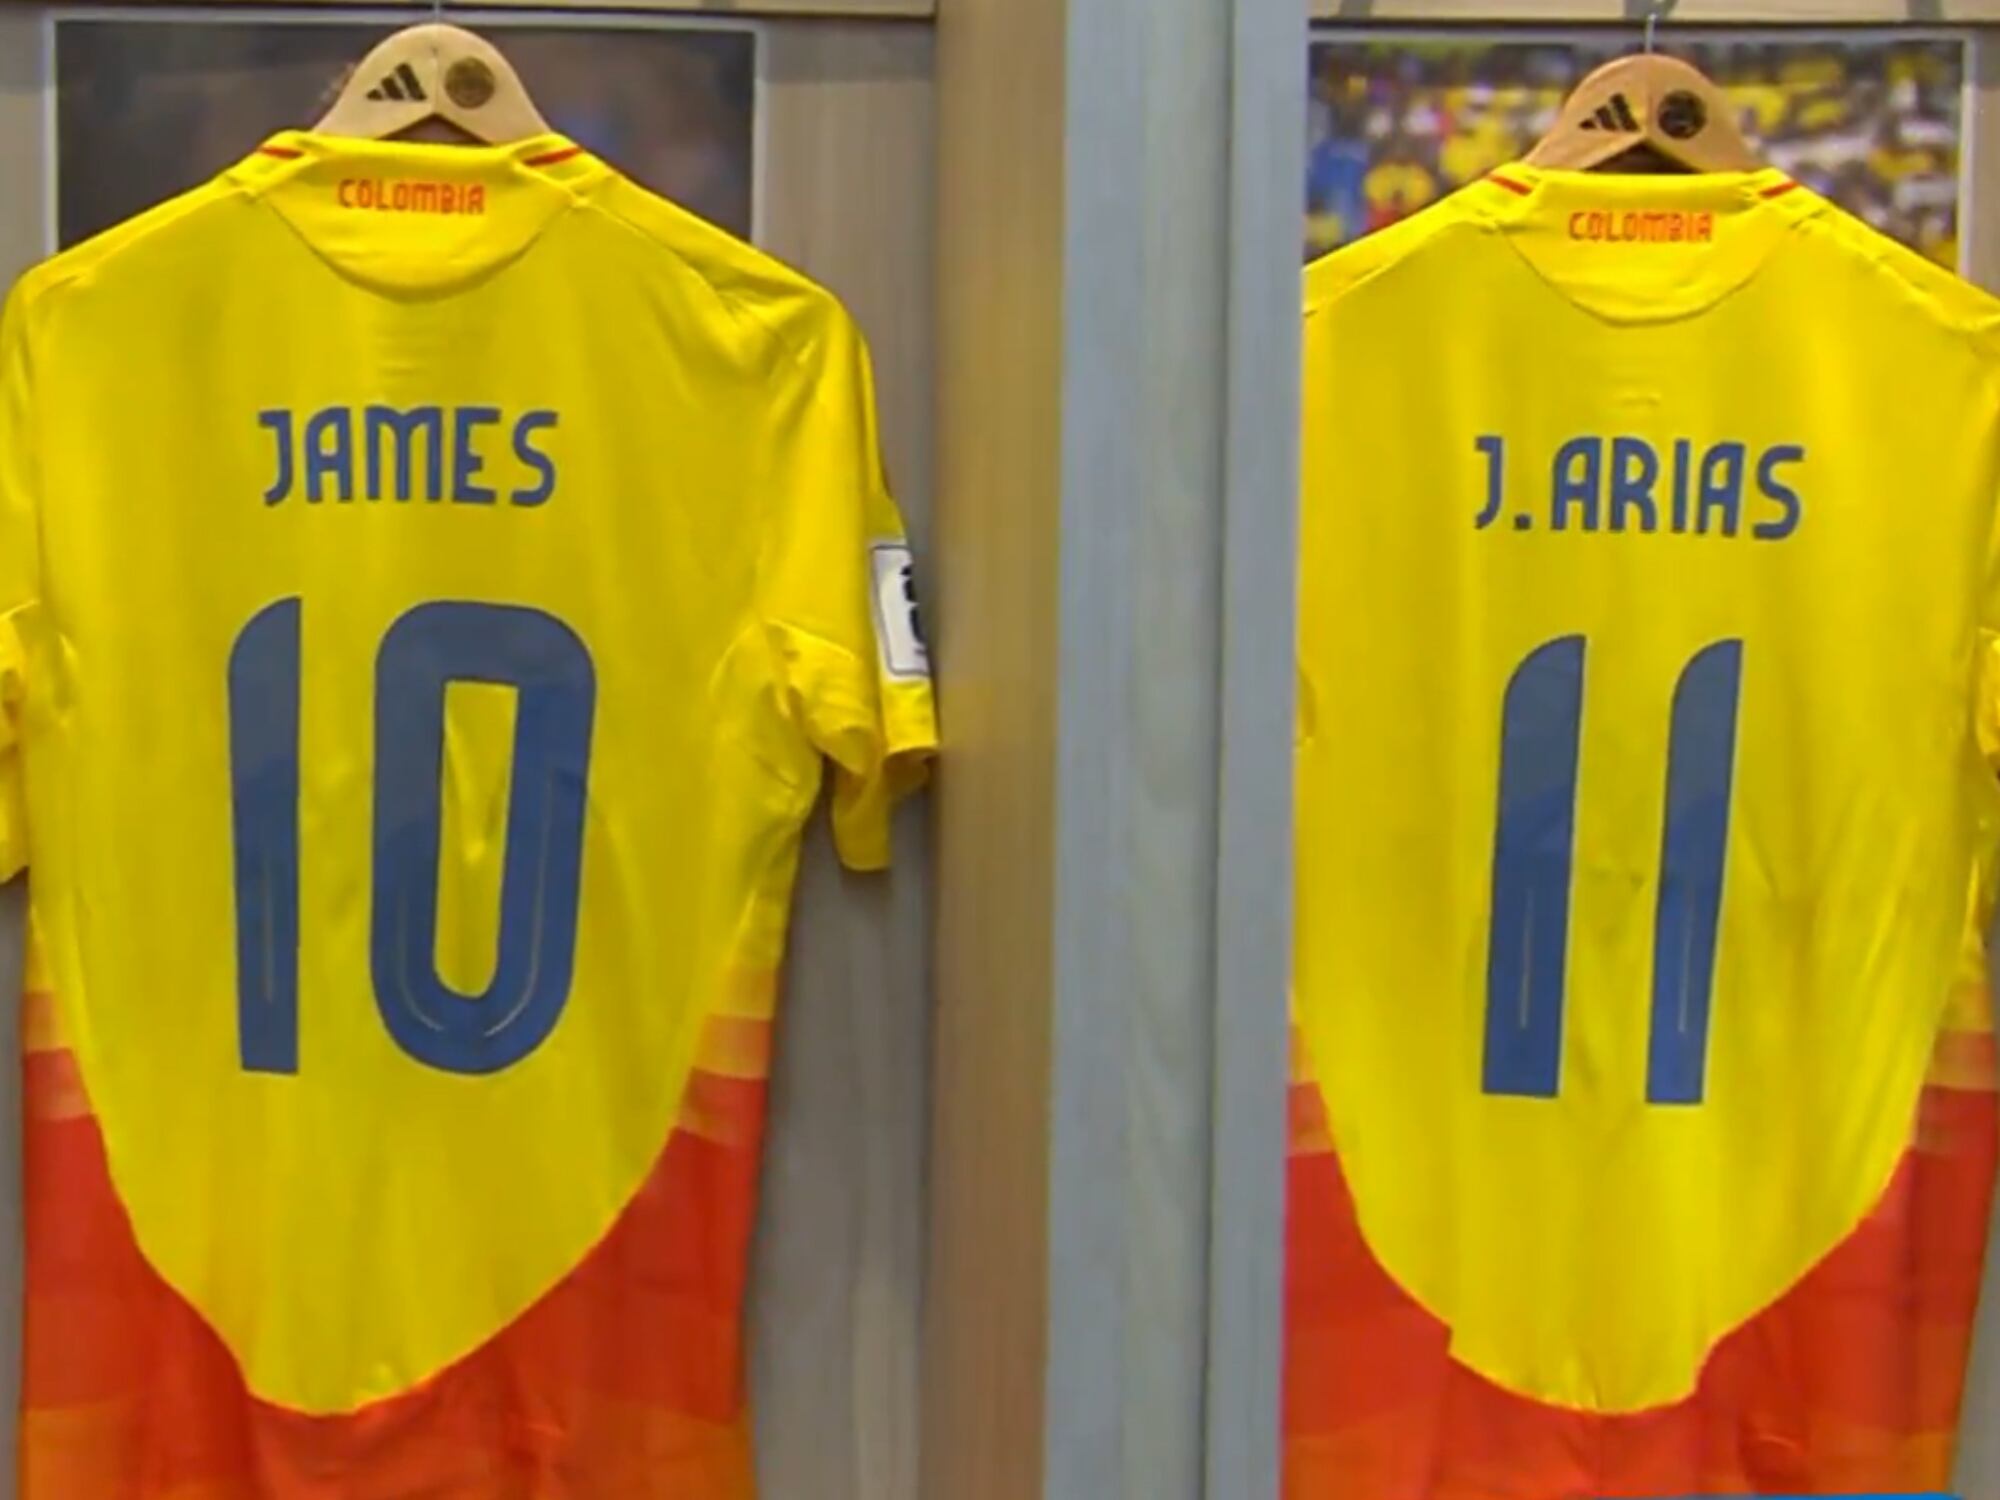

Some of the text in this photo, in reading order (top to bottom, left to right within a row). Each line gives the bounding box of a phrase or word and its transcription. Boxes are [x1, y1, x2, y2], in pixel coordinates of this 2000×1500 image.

[338, 179, 486, 214] COLOMBIA
[1569, 209, 1713, 242] COLOMBIA
[258, 406, 559, 508] JAMES
[227, 597, 597, 1076] 10
[1482, 634, 1743, 1104] 11
